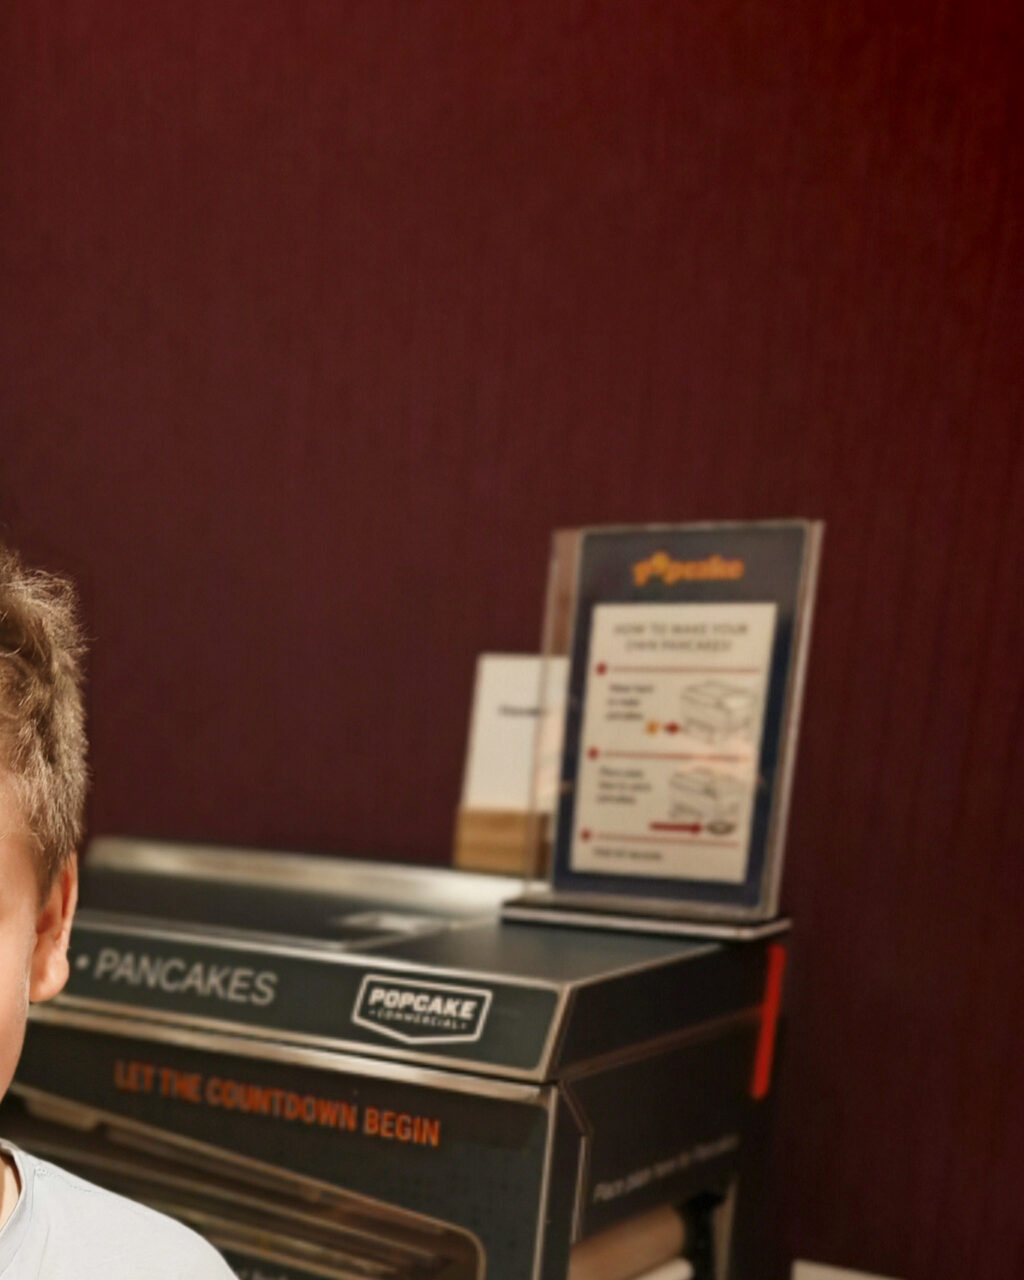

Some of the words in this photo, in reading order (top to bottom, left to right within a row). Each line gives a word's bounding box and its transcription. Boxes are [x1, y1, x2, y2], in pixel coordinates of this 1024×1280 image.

[94, 946, 279, 1007] PANCAKES
[367, 986, 478, 1020] POPCAKE
[114, 1059, 152, 1093] LET
[159, 1065, 202, 1102] THE
[205, 1075, 356, 1132] COUNTDOWN
[362, 1104, 440, 1146] BEGIN
